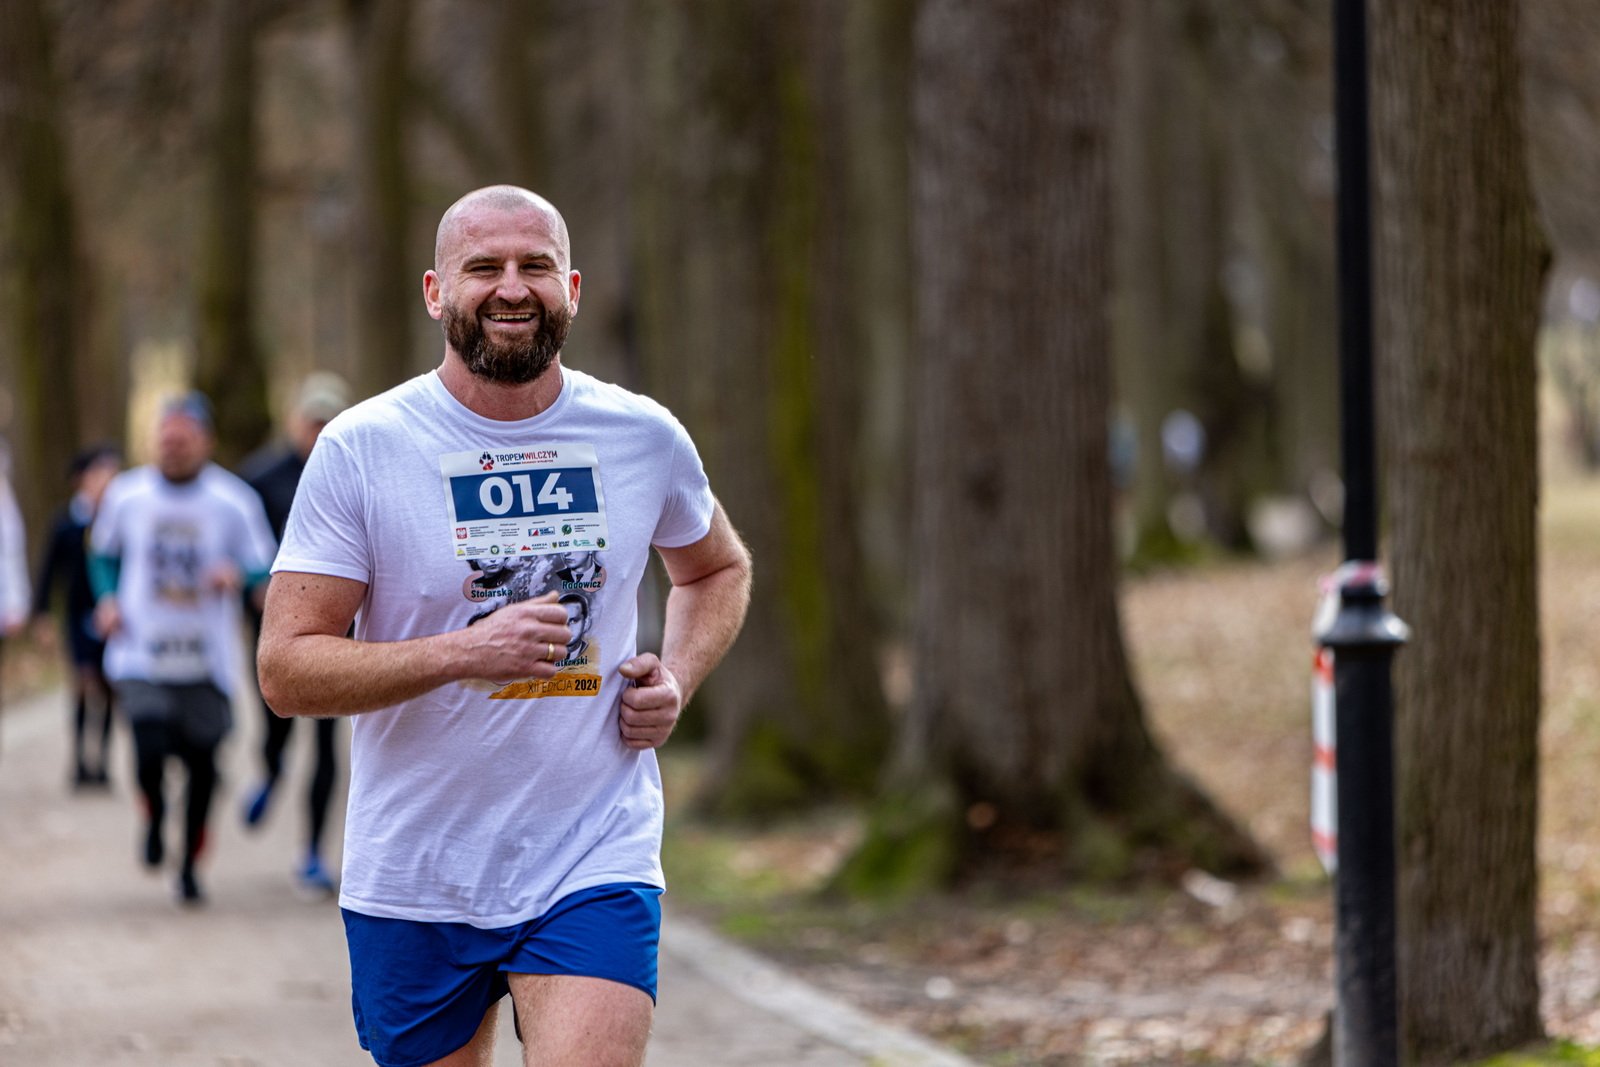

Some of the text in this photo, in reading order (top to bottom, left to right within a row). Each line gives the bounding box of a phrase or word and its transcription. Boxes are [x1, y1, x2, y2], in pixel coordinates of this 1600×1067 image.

[479, 472, 574, 516] 014
[562, 580, 601, 590] Rodowicz
[471, 589, 513, 599] Stolarska
[542, 680, 573, 693] EDYCJA
[575, 679, 598, 691] 2024
